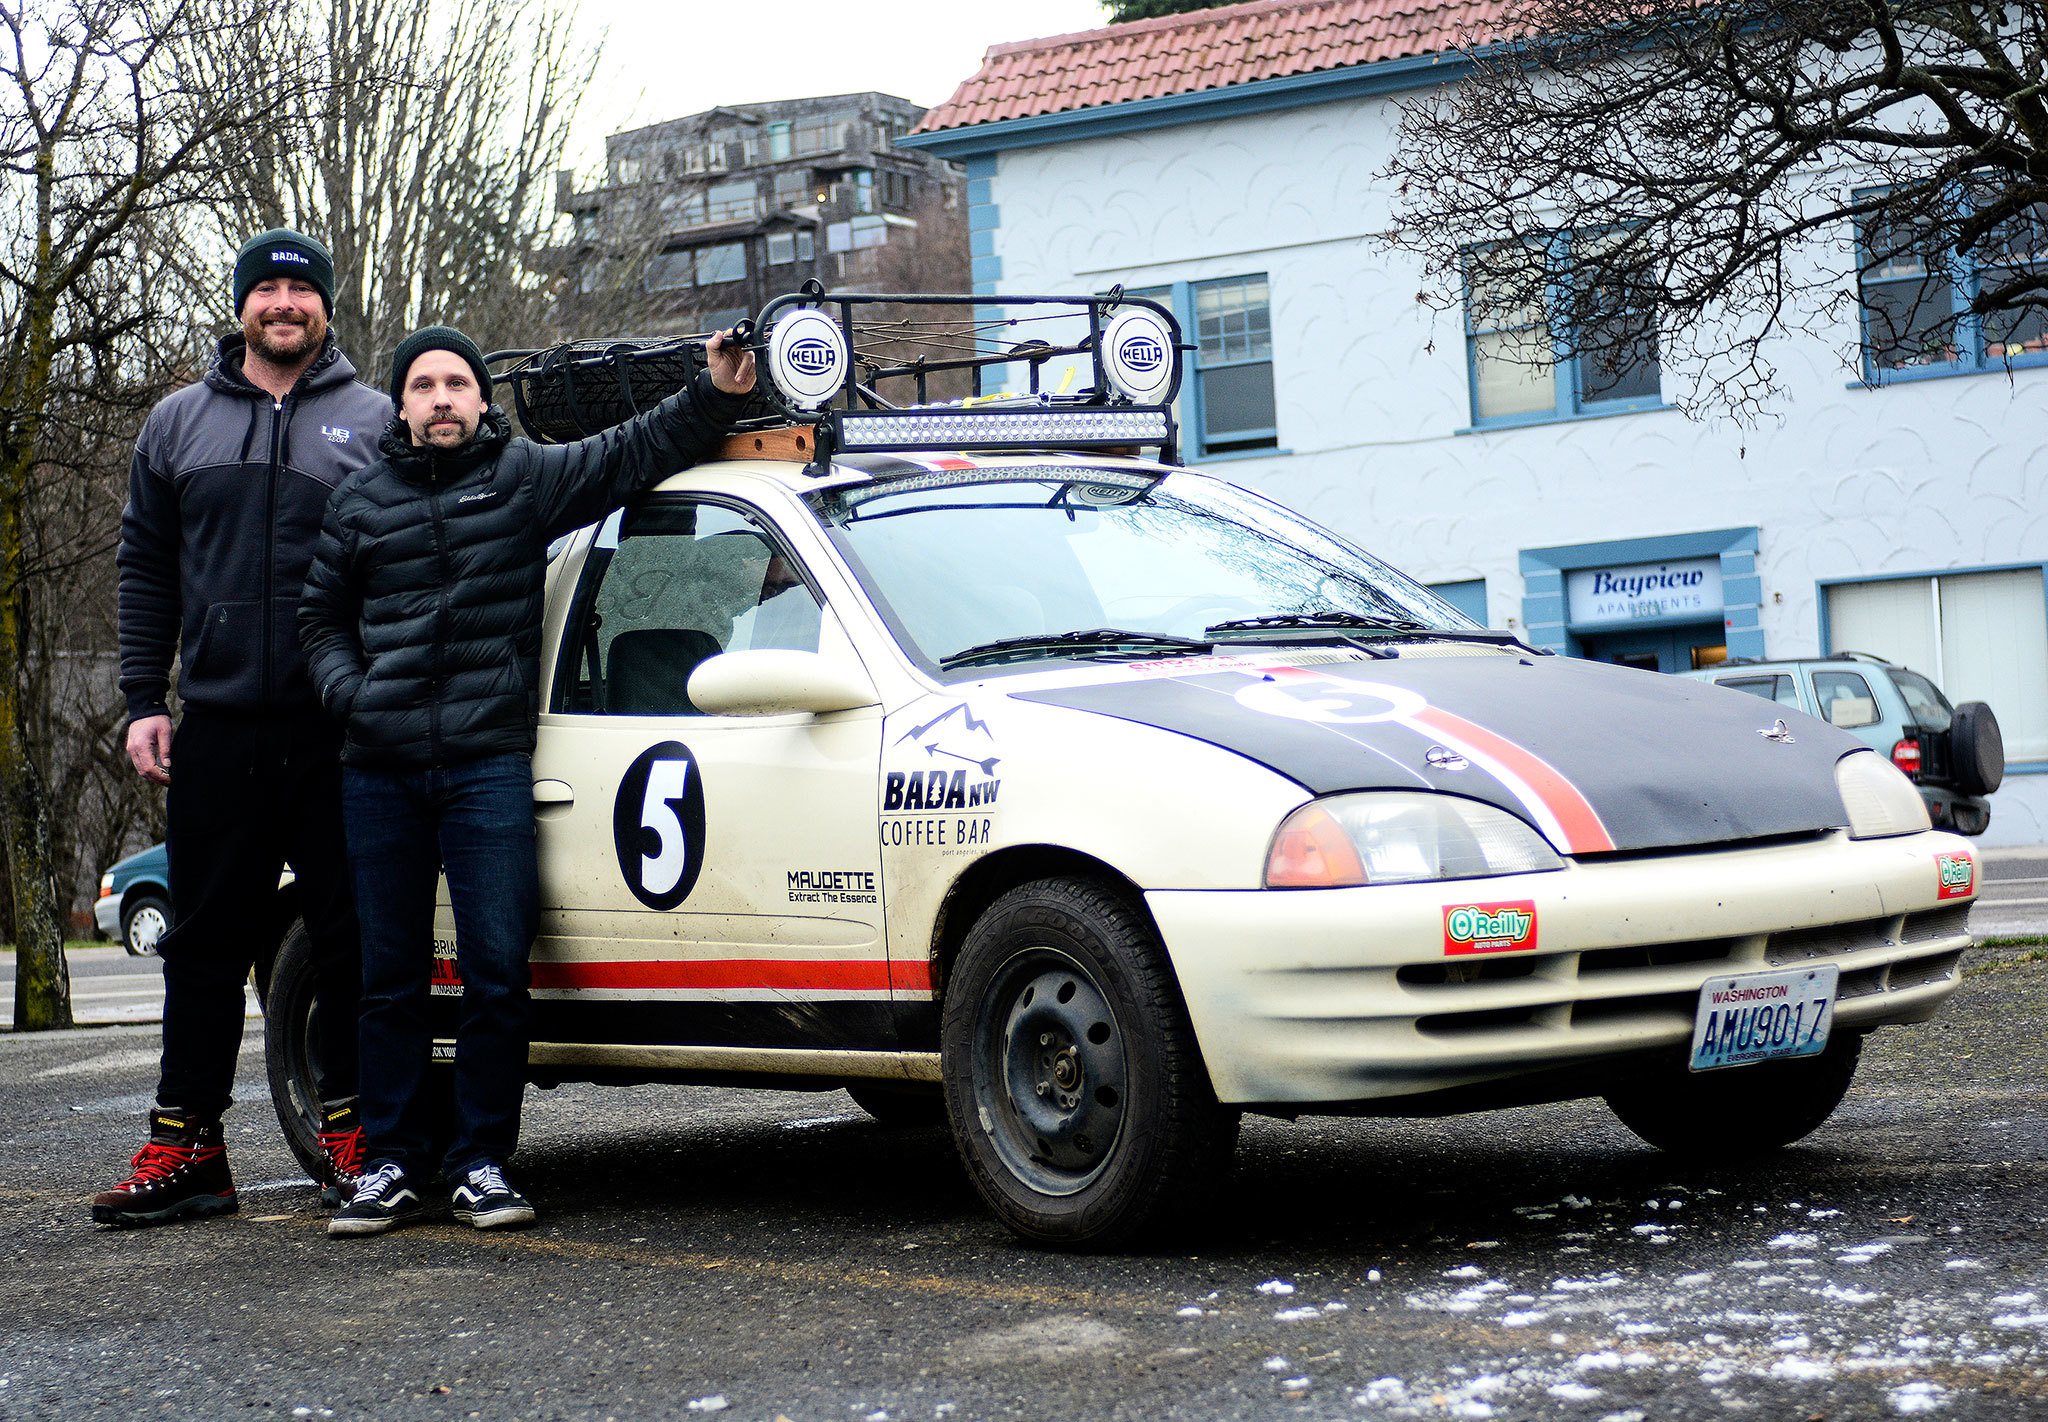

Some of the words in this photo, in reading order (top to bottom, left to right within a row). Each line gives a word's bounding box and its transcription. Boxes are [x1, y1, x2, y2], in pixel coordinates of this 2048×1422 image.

[271, 252, 299, 262] BADA
[791, 350, 836, 366] HELLA
[1123, 347, 1163, 362] HELLA
[321, 425, 350, 439] LIB
[1593, 566, 1704, 598] Bayview
[884, 770, 967, 811] BADA
[640, 759, 688, 896] 5
[881, 819, 946, 846] COFFEE
[957, 819, 991, 845] BAR
[787, 871, 875, 890] MAUDETTE
[788, 892, 821, 903] Extract
[822, 892, 838, 903] The
[840, 893, 877, 904] Essence
[1452, 911, 1527, 937] O'Reilly
[1713, 985, 1788, 1004] WASHINGTON
[1700, 998, 1827, 1056] AMU9017
[1727, 1053, 1767, 1063] EVERGREEN
